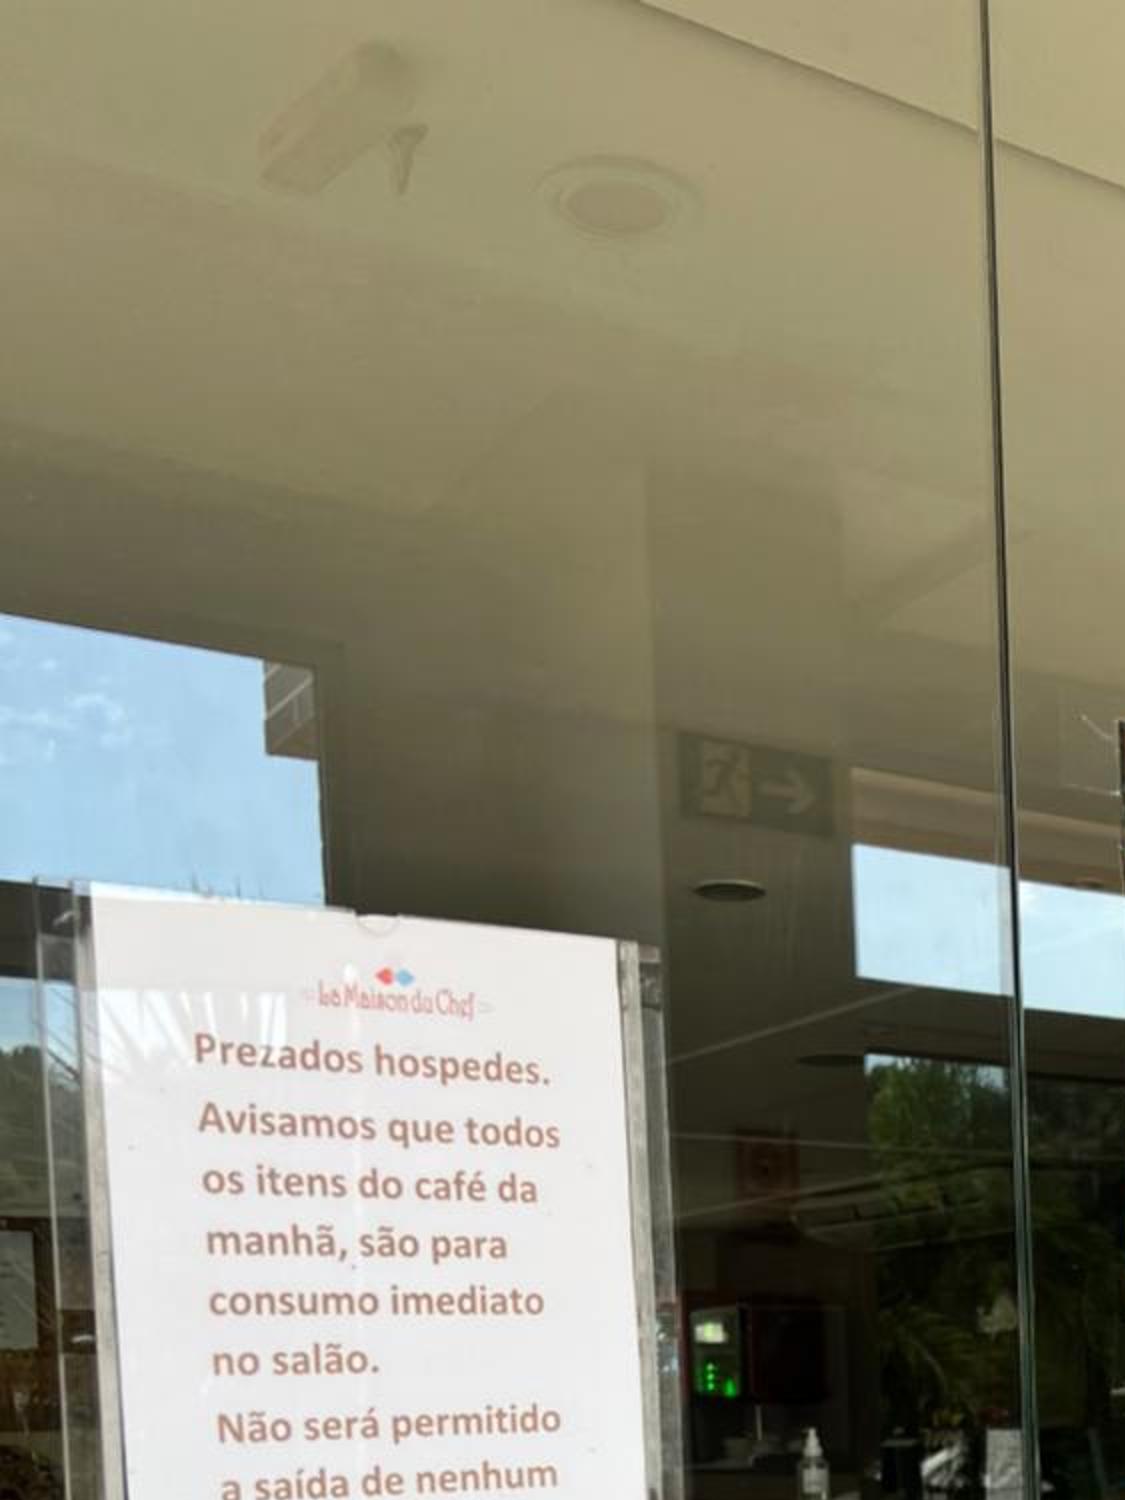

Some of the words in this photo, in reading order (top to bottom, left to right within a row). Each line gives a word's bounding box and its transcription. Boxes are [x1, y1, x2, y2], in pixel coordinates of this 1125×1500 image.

[344, 982, 408, 1011] Maison
[436, 986, 475, 1021] Chef
[193, 1033, 363, 1075] Prezados
[374, 1044, 551, 1085] hospedes.
[199, 1102, 377, 1141] Avisamos
[388, 1119, 455, 1149] que
[465, 1117, 561, 1148] todos
[202, 1169, 244, 1195] os
[255, 1164, 348, 1198] itens
[358, 1168, 403, 1199] do
[414, 1170, 487, 1201] café
[498, 1173, 538, 1203] da
[206, 1224, 349, 1262] manhã,
[359, 1226, 420, 1258] são
[430, 1234, 508, 1265] para
[208, 1290, 379, 1316] consumo
[390, 1284, 545, 1316] imediato
[212, 1351, 260, 1377] no
[272, 1343, 379, 1376] salão.
[217, 1410, 293, 1444] Não
[303, 1406, 380, 1441] será
[391, 1402, 562, 1444] permitido
[361, 1465, 405, 1496] de
[415, 1460, 559, 1494] nenhum
